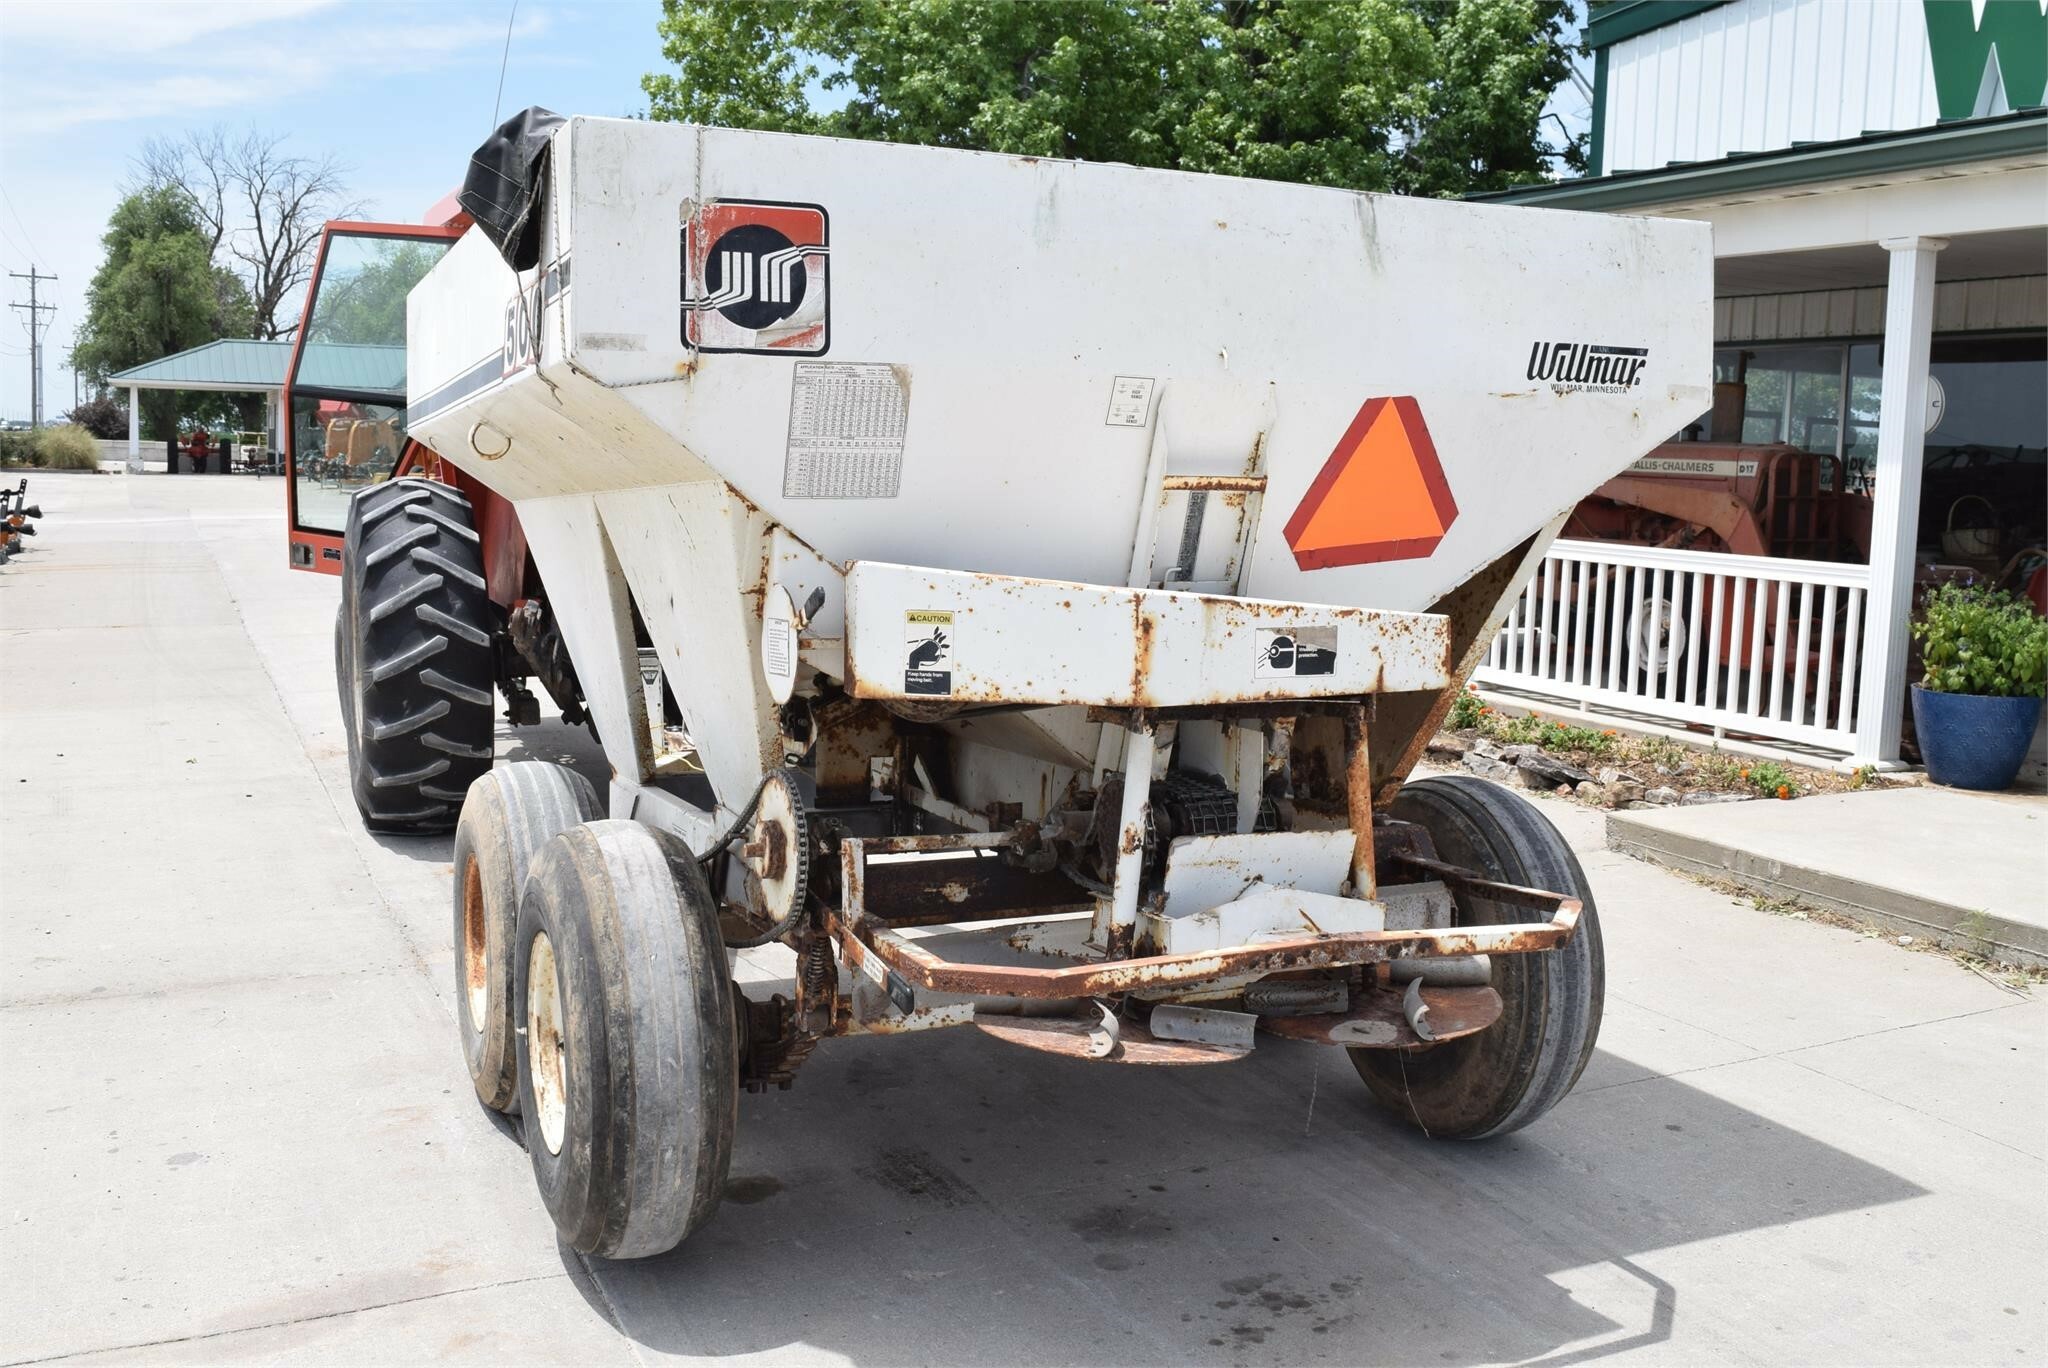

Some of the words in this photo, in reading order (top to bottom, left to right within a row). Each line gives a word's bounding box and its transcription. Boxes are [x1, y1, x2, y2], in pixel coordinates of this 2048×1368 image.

[1526, 341, 1647, 386] Willmar
[1586, 385, 1627, 394] MINNESOTA
[916, 615, 951, 623] CAUTION
